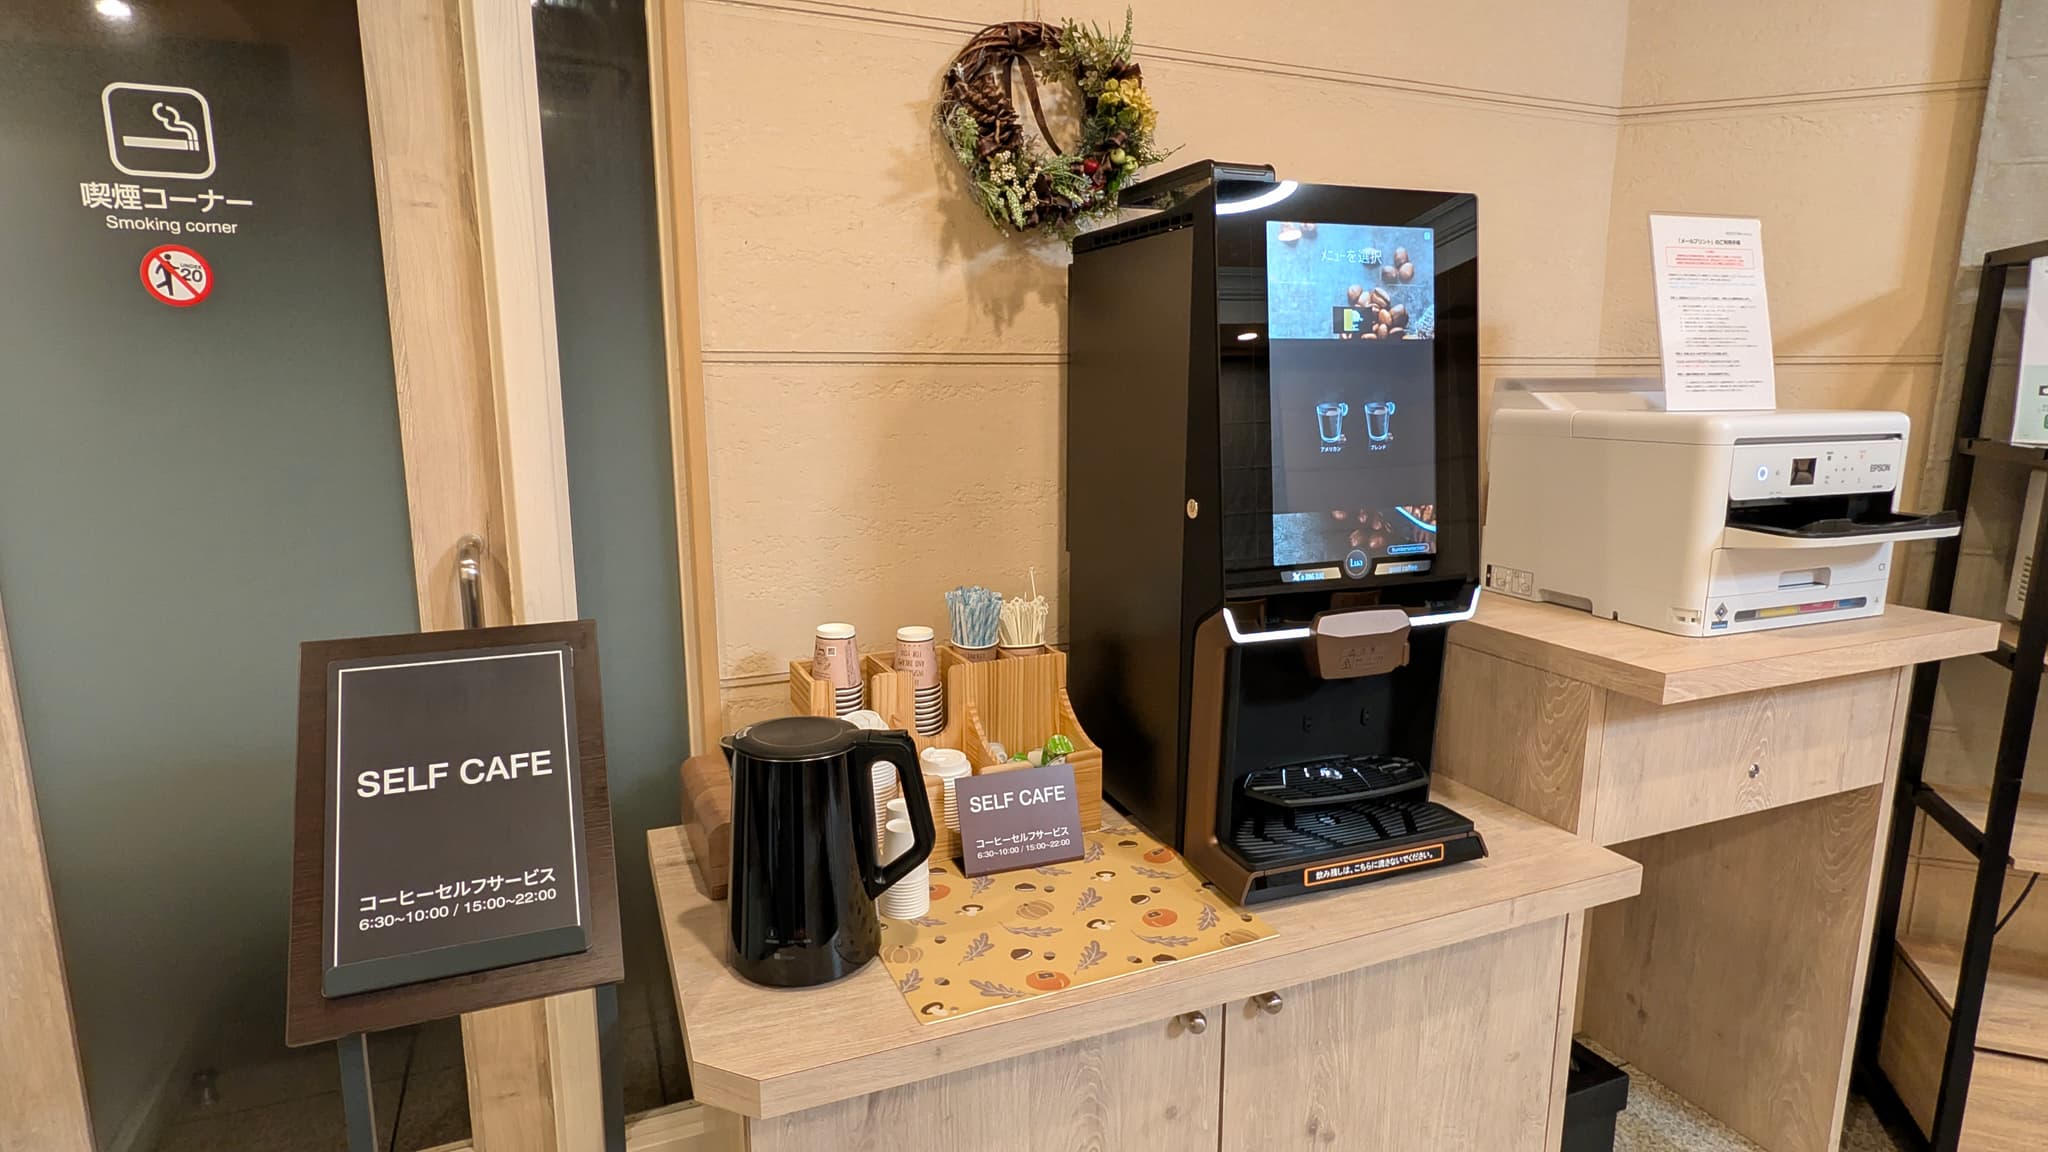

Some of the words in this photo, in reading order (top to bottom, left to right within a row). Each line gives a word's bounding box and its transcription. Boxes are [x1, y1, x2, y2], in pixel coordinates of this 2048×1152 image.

[80, 182, 253, 212] 喫煙コーナー
[106, 215, 181, 234] Smoking
[185, 220, 238, 234] corner
[1320, 249, 1383, 264] メニューを選択
[180, 267, 203, 282] 20
[1869, 463, 1891, 473] EPSON
[356, 762, 449, 798] SELF
[459, 750, 553, 785] CAFE
[969, 792, 1014, 813] SELF
[1019, 785, 1066, 805] CAFE
[976, 827, 1070, 848] コーヒーセルフサービス
[360, 867, 557, 912] コーヒーセルフサービス
[359, 905, 449, 931] 6:30~10:00
[464, 888, 557, 913] 15:00~22:00
